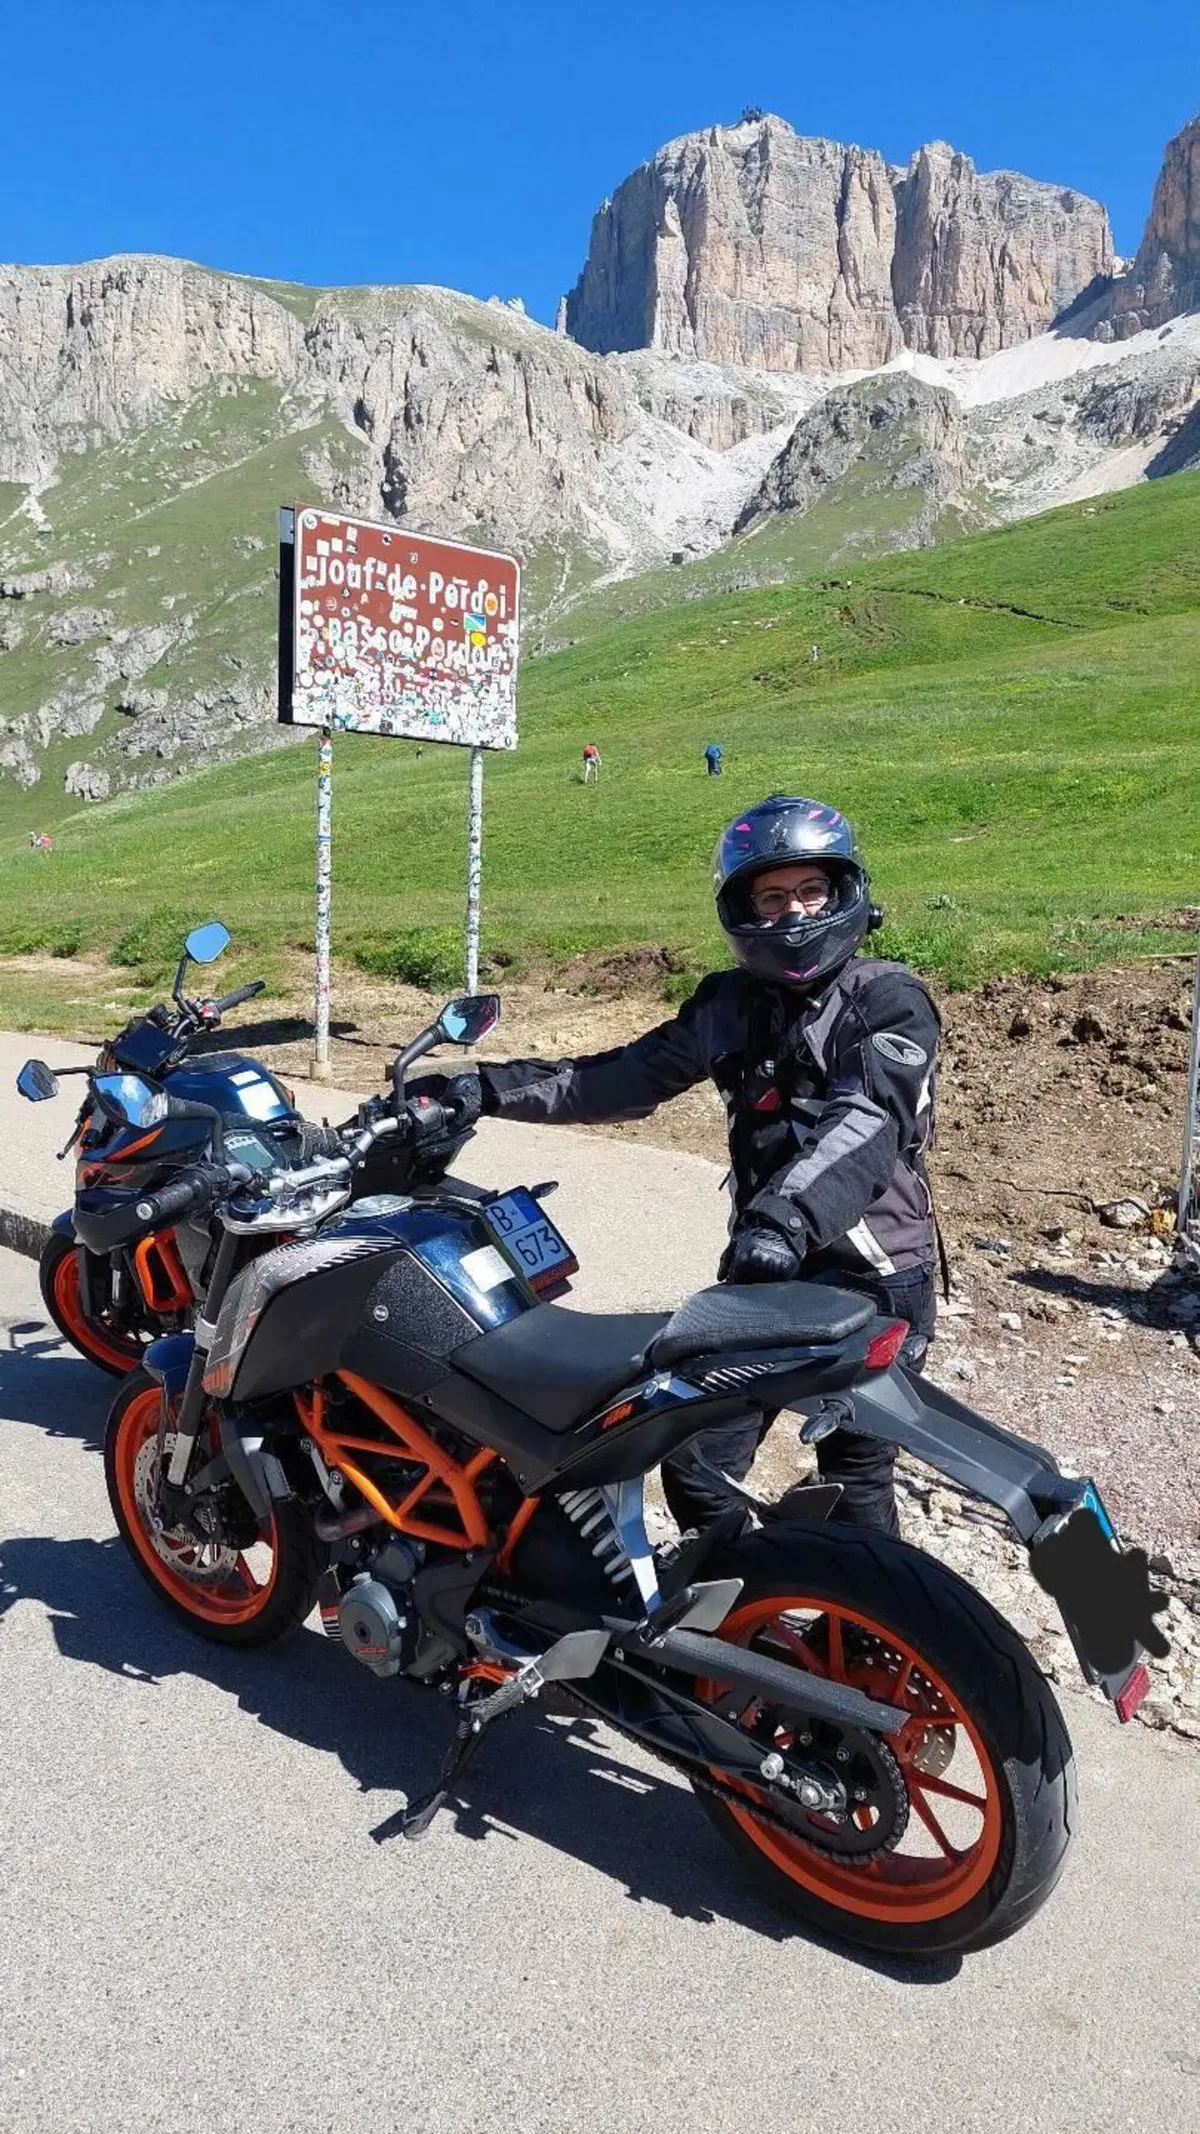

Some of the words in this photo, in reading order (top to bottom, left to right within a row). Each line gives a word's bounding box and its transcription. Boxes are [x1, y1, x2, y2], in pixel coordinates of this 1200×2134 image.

[387, 563, 417, 600] de
[429, 571, 506, 619] Pordoi
[515, 1226, 562, 1266] 673
